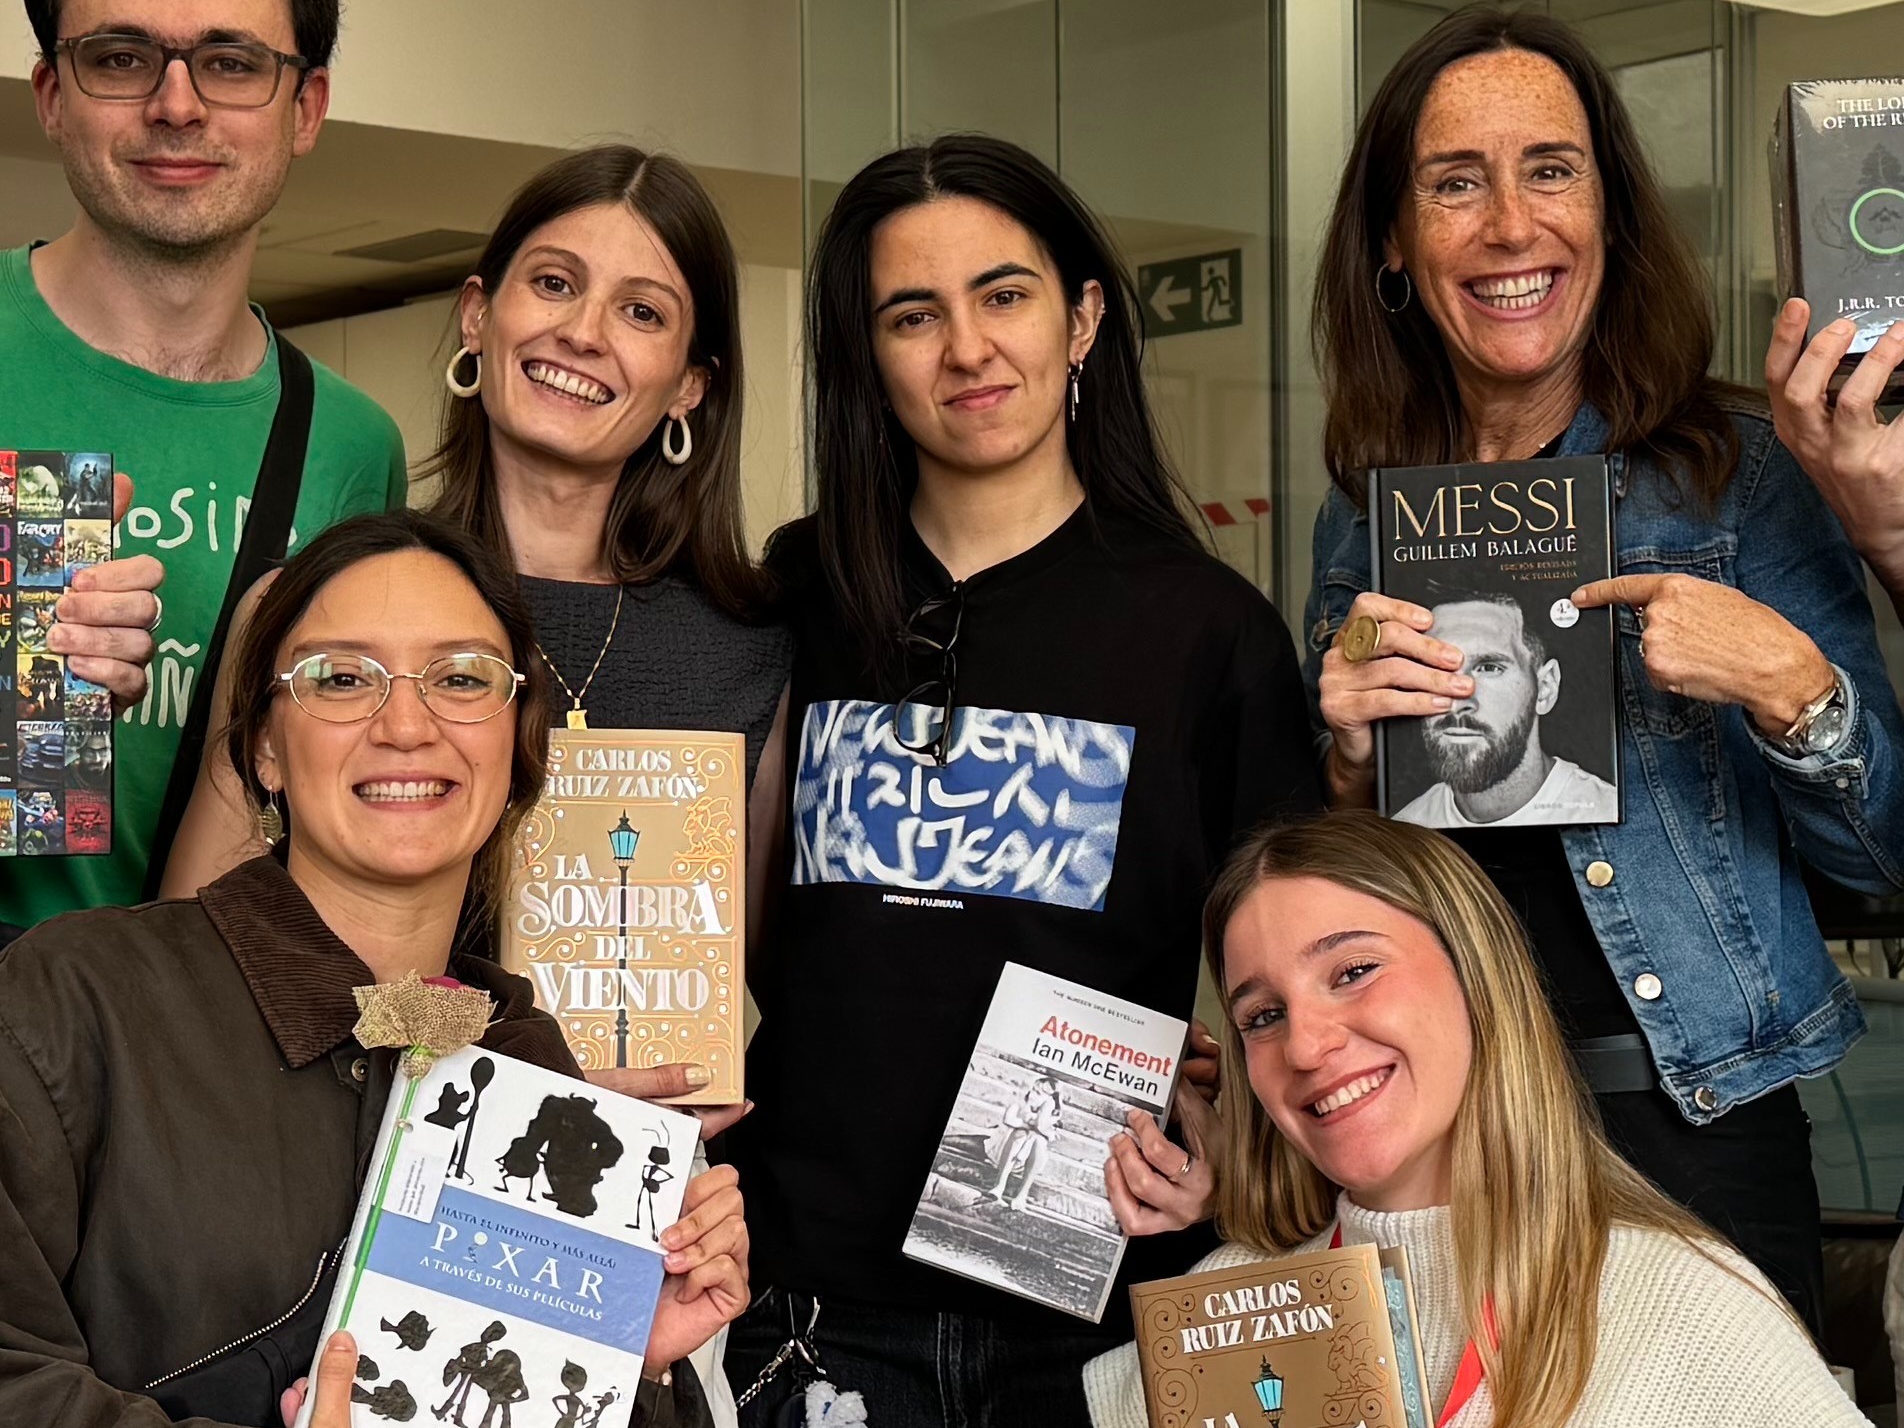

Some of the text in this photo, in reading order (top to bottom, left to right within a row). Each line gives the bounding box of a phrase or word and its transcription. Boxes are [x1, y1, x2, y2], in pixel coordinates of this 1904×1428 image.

[1823, 116, 1846, 130] OF
[1850, 113, 1887, 128] THE
[1837, 98, 1873, 113] THE
[1838, 296, 1881, 314] J.R.R.
[1391, 478, 1577, 540] MESSI
[1393, 534, 1578, 564] GUILLEM BALAGUÉ
[576, 748, 672, 772] CARLOS
[547, 771, 701, 800] RUIZ ZAFÓN
[554, 853, 594, 881] LA
[517, 879, 729, 936] SOMBRA
[594, 936, 653, 961] DEL
[529, 962, 710, 1013] VIENTO
[1032, 1037, 1158, 1096] Ian McEwan
[1040, 1015, 1172, 1077] Atonement
[441, 1205, 477, 1225] HASTA
[480, 1218, 492, 1230] EL
[495, 1224, 550, 1247] INFINITO
[419, 1256, 603, 1321] A TRAVÉS DE SUS PELÍCULAS
[1203, 1279, 1302, 1320] CARLOS
[1180, 1303, 1335, 1355] RUIZ ZAFÓN
